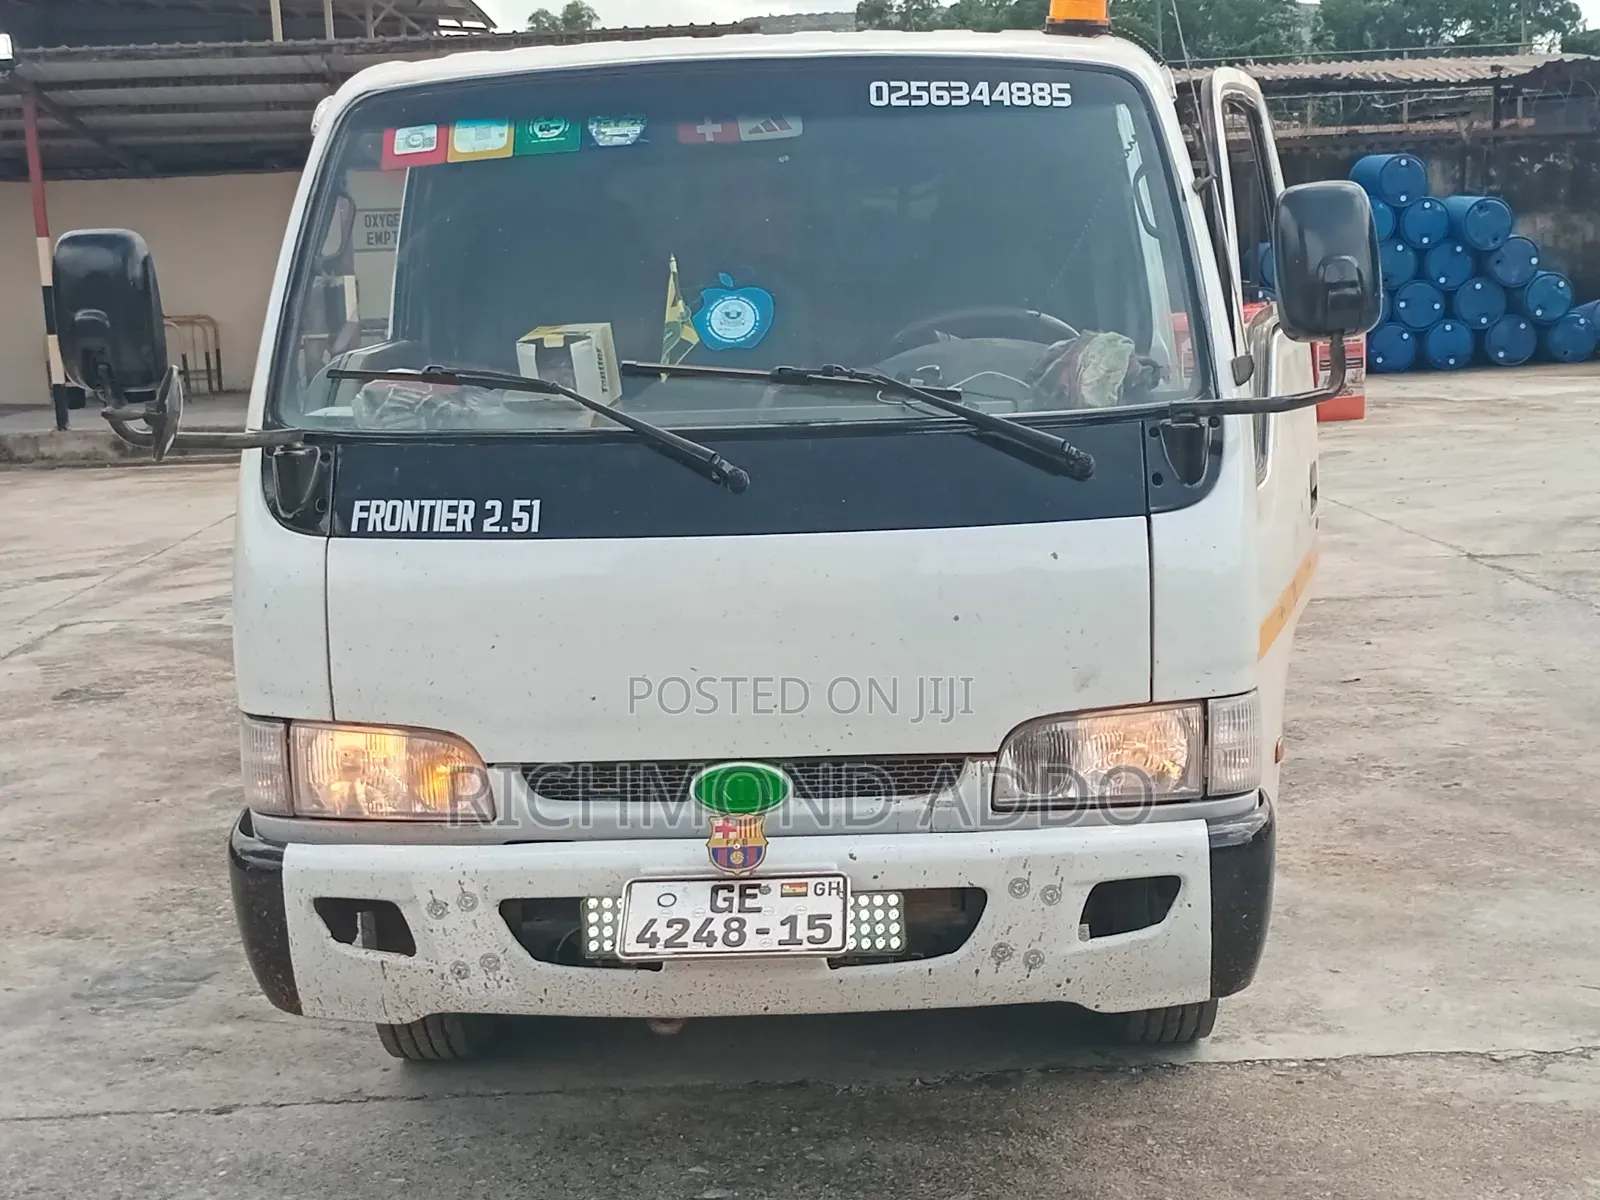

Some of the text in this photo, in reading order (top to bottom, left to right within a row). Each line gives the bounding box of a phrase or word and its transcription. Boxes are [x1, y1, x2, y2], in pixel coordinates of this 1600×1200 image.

[869, 81, 1072, 107] 0256344885
[350, 499, 475, 533] FRONTIER
[709, 883, 763, 914] GE
[813, 881, 841, 897] GH
